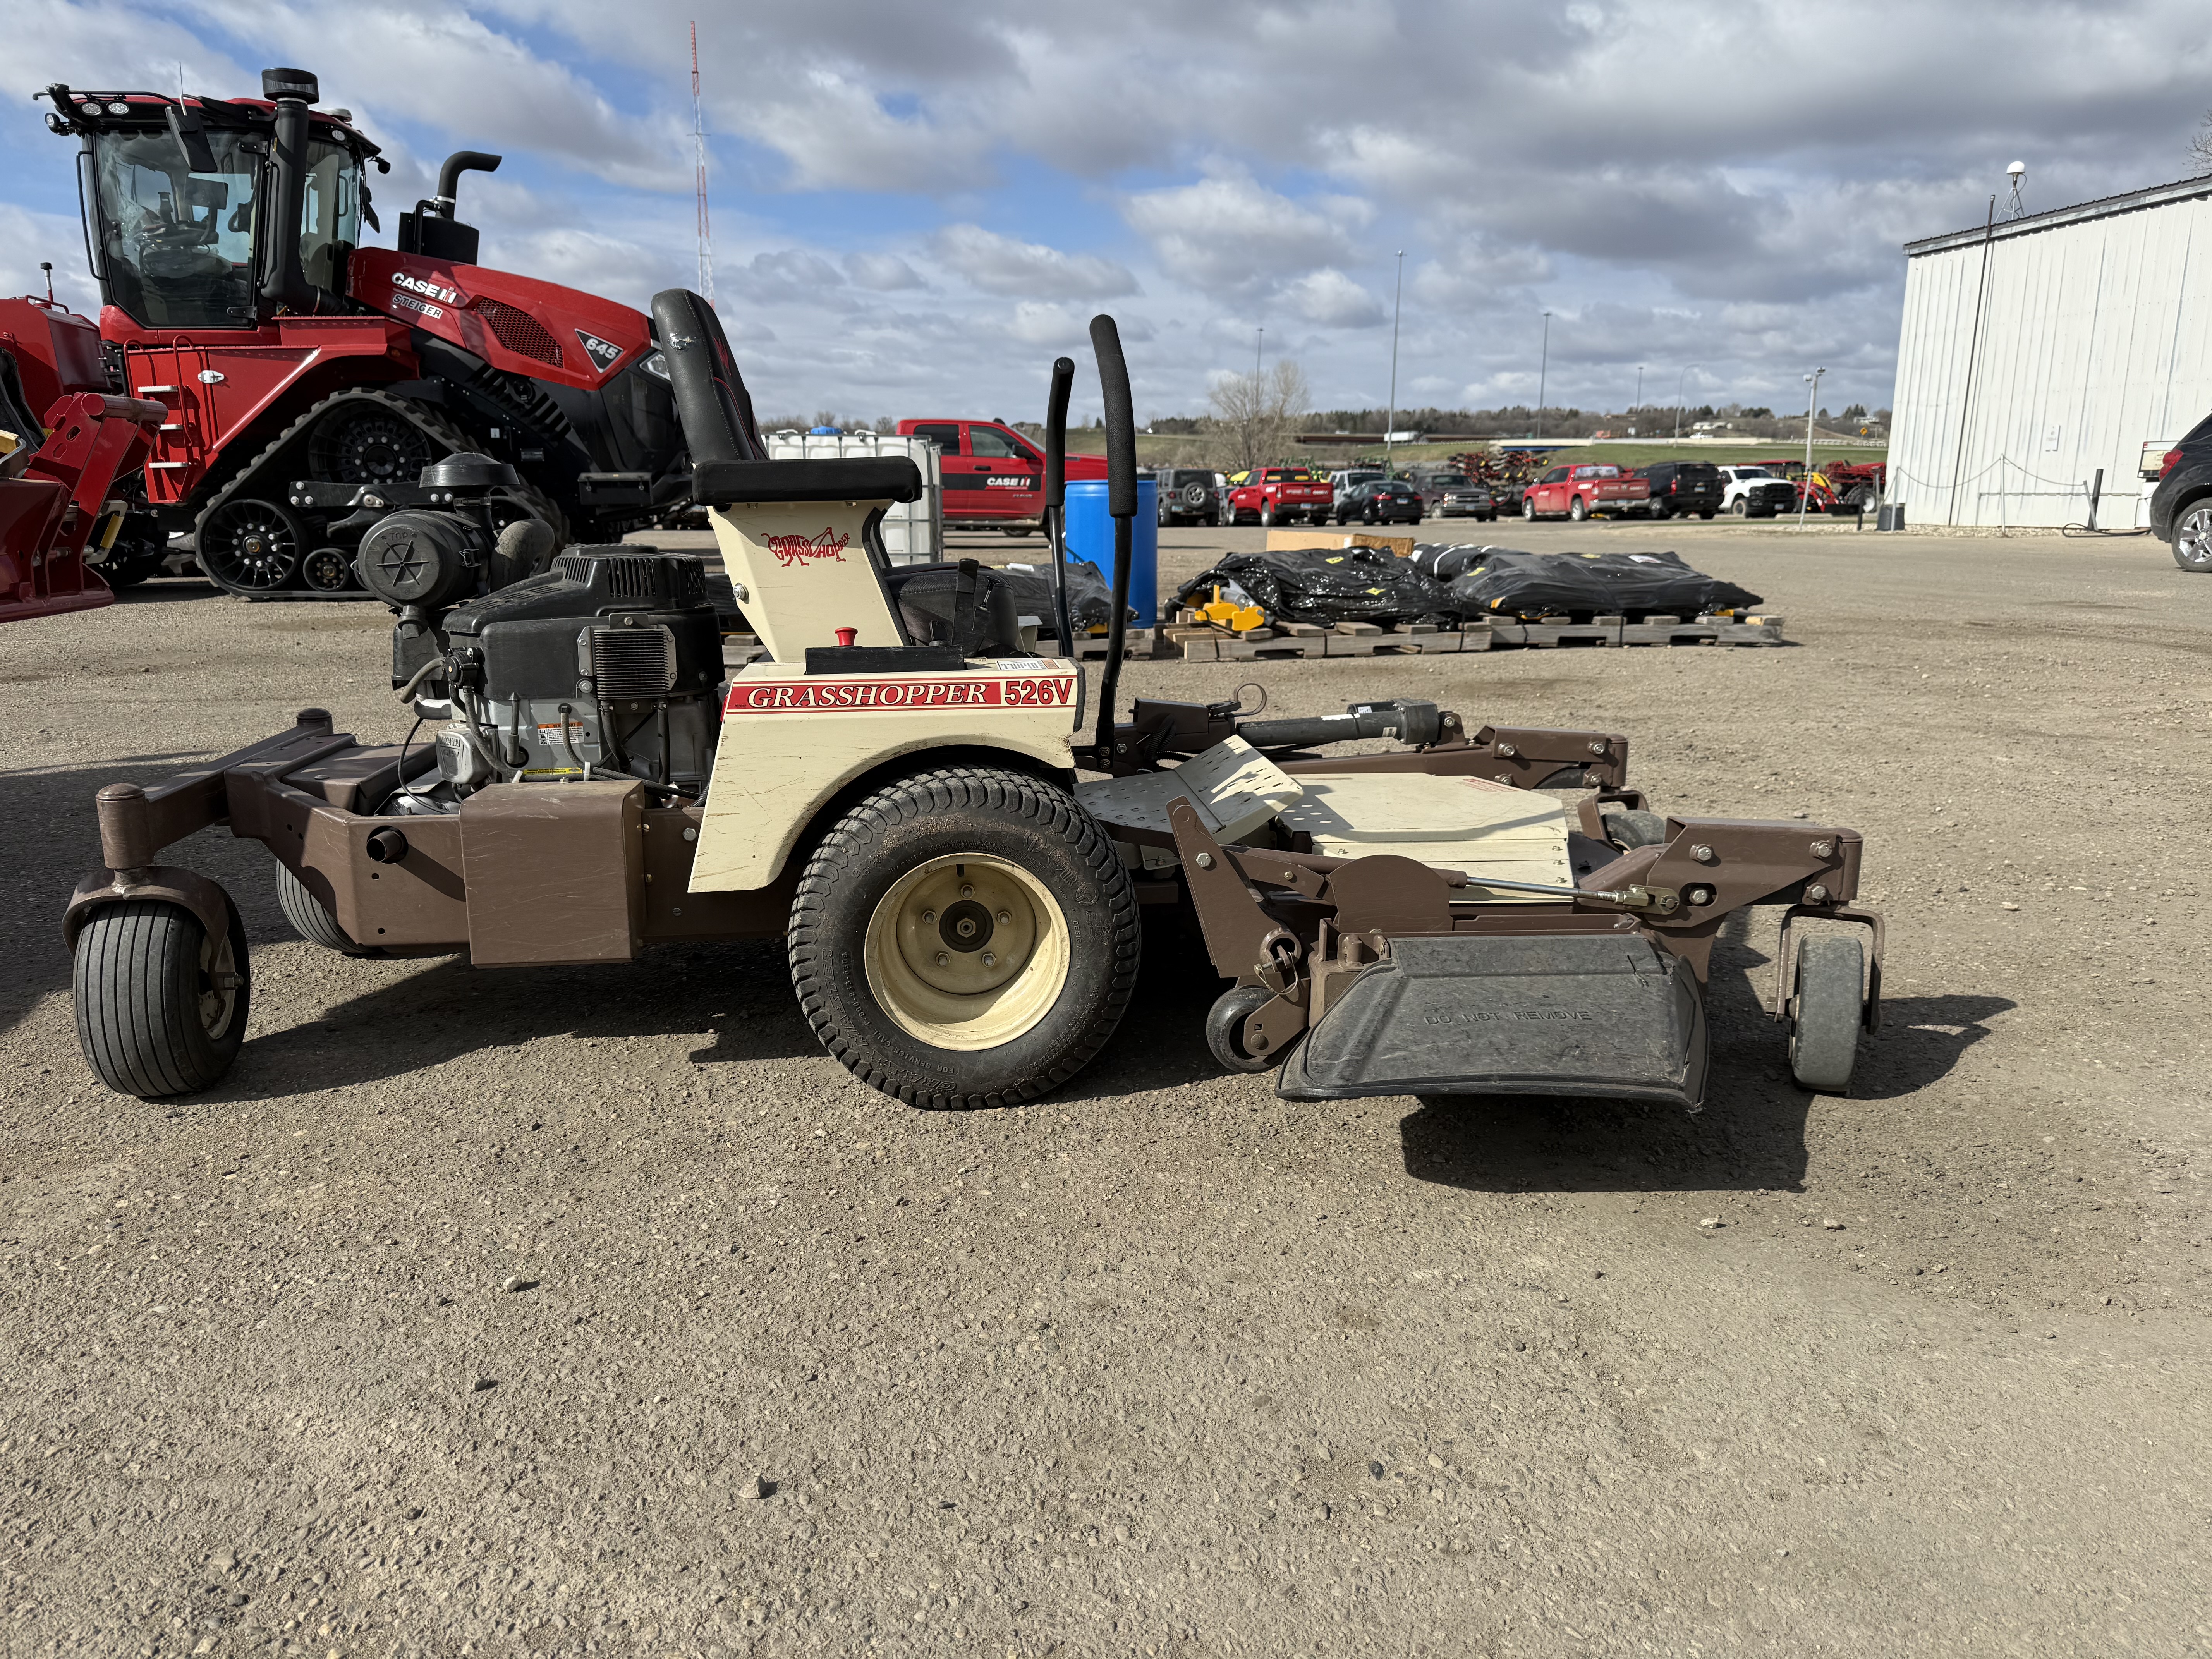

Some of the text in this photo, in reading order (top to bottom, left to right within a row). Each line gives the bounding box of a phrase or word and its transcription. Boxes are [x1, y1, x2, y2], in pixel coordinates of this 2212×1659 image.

[392, 272, 440, 297] CASE
[393, 294, 442, 318] STEIGER
[586, 338, 618, 359] 645
[987, 477, 1018, 486] CASE
[388, 532, 408, 541] TOP
[748, 679, 1073, 708] GRASSHOPPER 526V
[1424, 1011, 1592, 1025] DO NOT REMOVE
[873, 1029, 891, 1047] CALL
[893, 1046, 932, 1069] SERVICE
[937, 1065, 955, 1074] FOR
